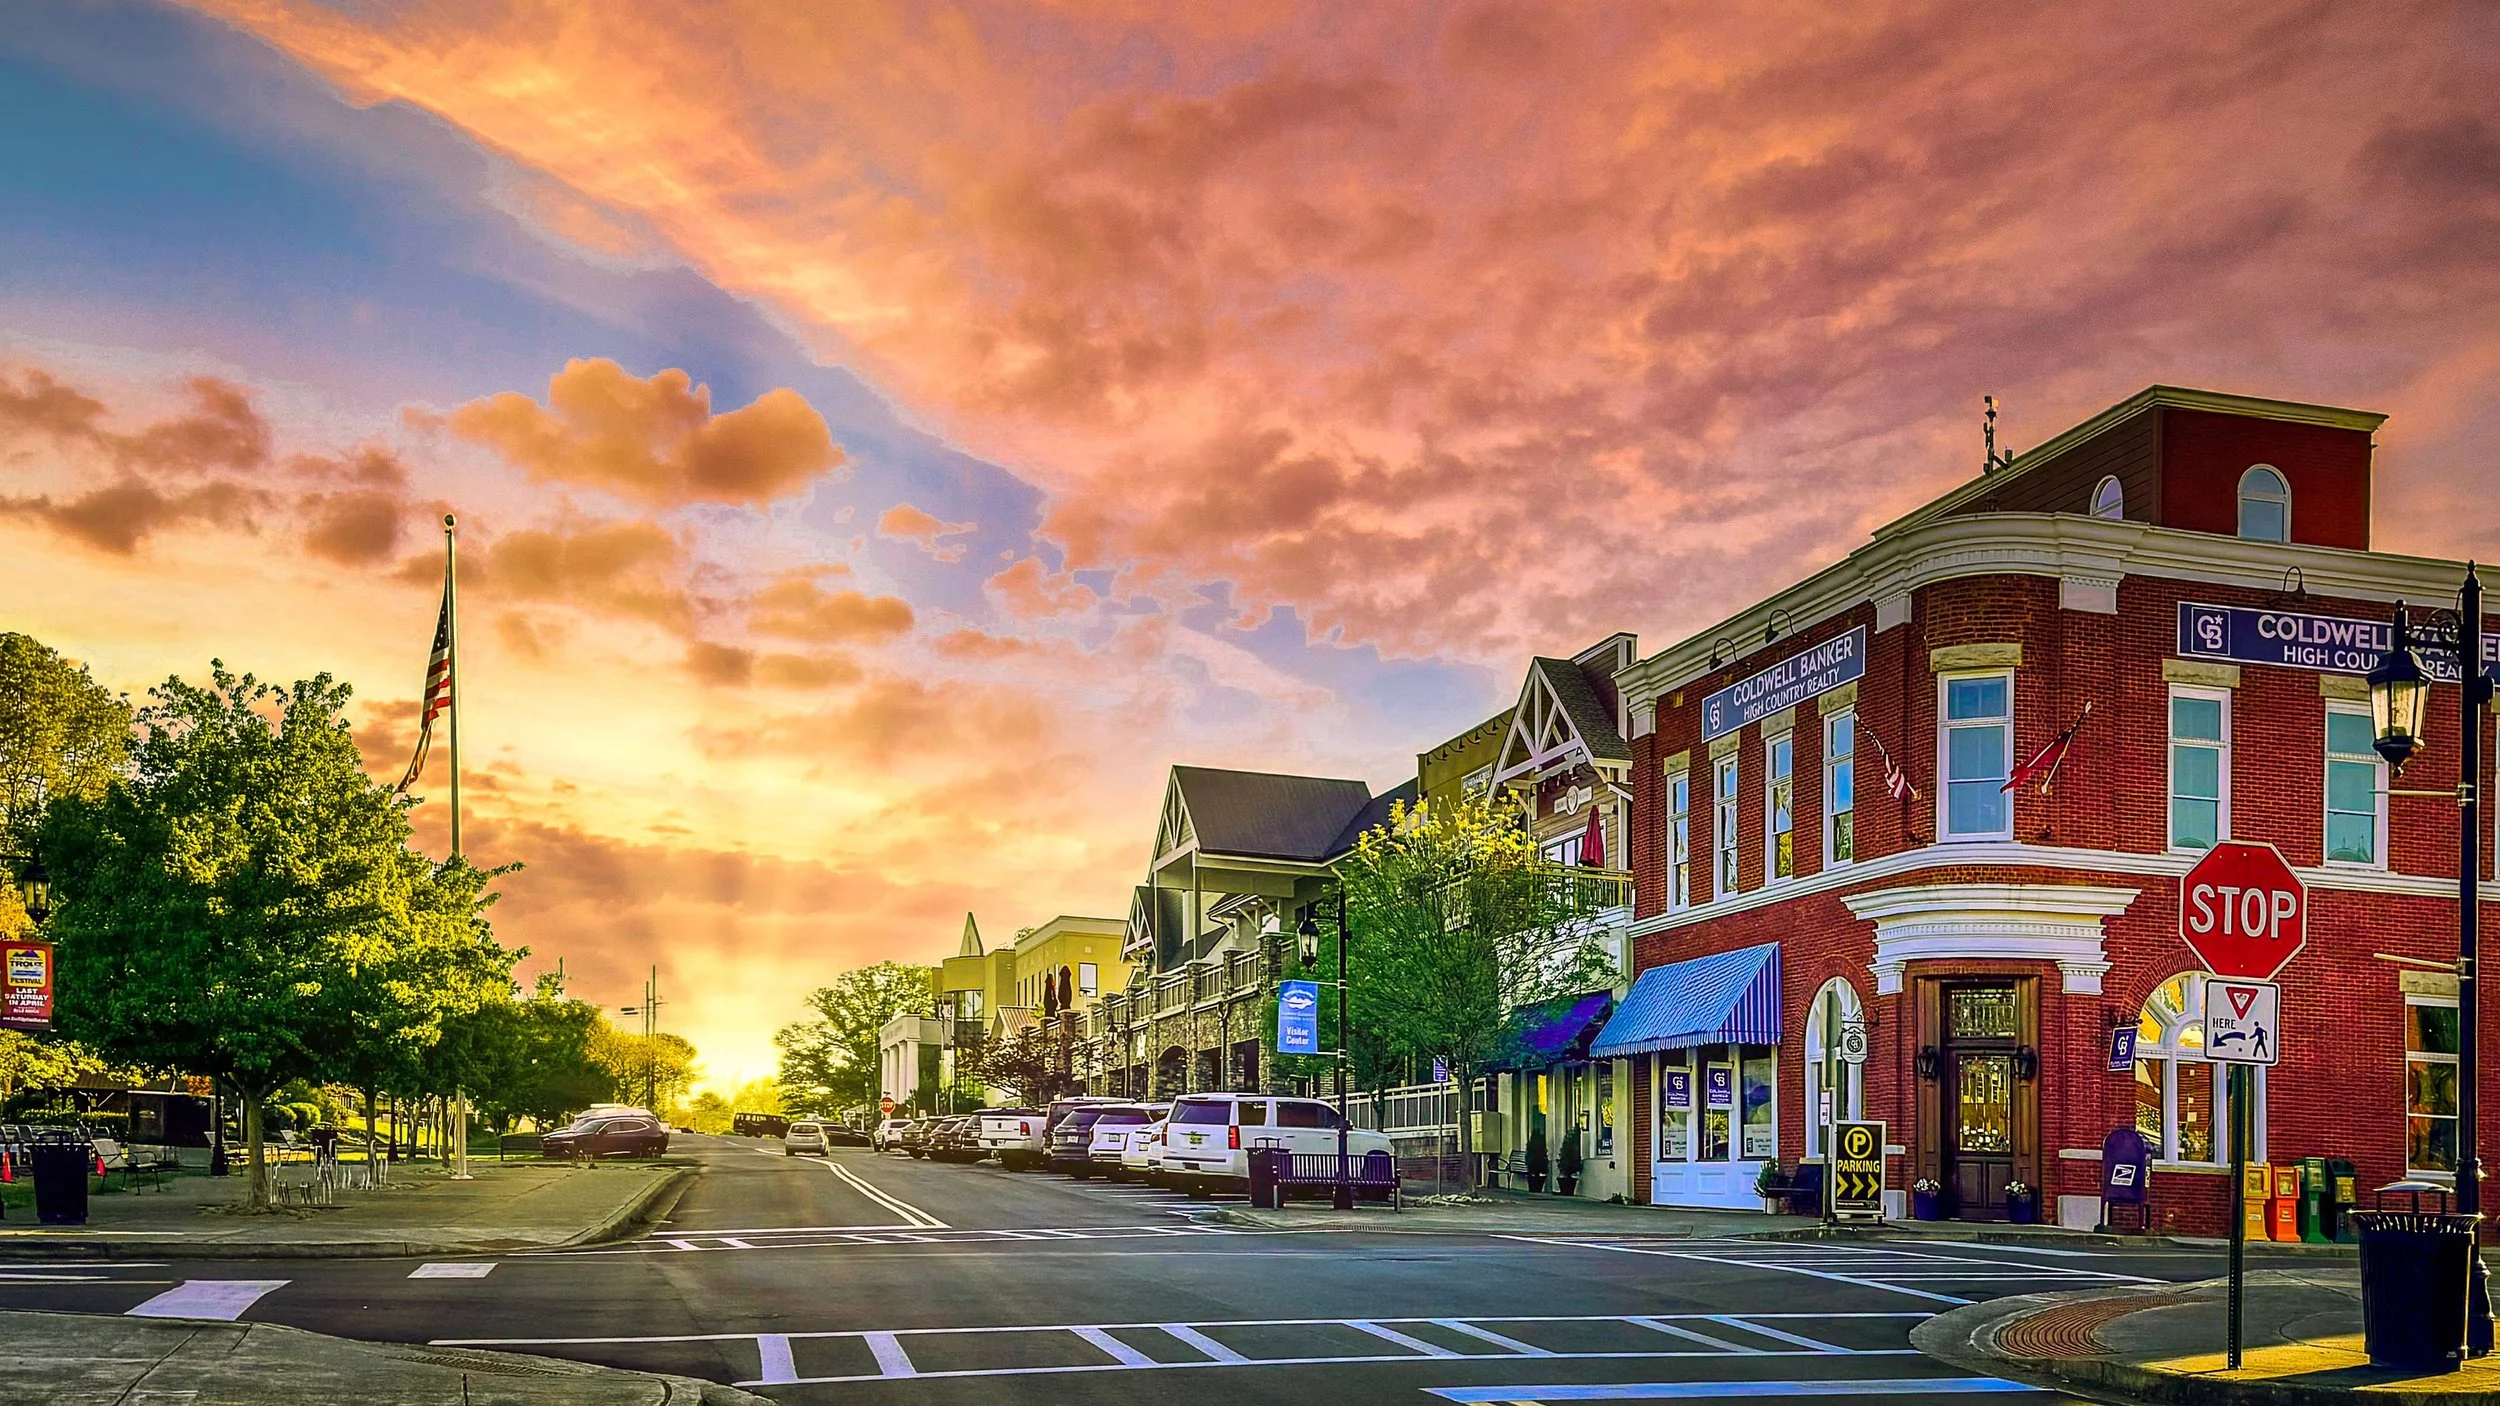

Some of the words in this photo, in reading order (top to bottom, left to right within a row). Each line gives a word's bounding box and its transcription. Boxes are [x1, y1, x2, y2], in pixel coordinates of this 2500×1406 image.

[2257, 614, 2393, 651] COLDWELL
[2283, 645, 2329, 665] HIGH
[1733, 662, 1797, 706] COLDWELL
[1800, 635, 1853, 679] BANKER
[1743, 704, 1764, 722] HIGH
[1765, 681, 1807, 711] COUNTRY
[1807, 667, 1840, 695] REALTY
[2189, 883, 2297, 939] STOP
[5, 993, 49, 1001] SATURDAY
[2212, 1017, 2236, 1030] HERE
[1852, 1133, 1867, 1153] P
[1837, 1159, 1880, 1173] PARKING
